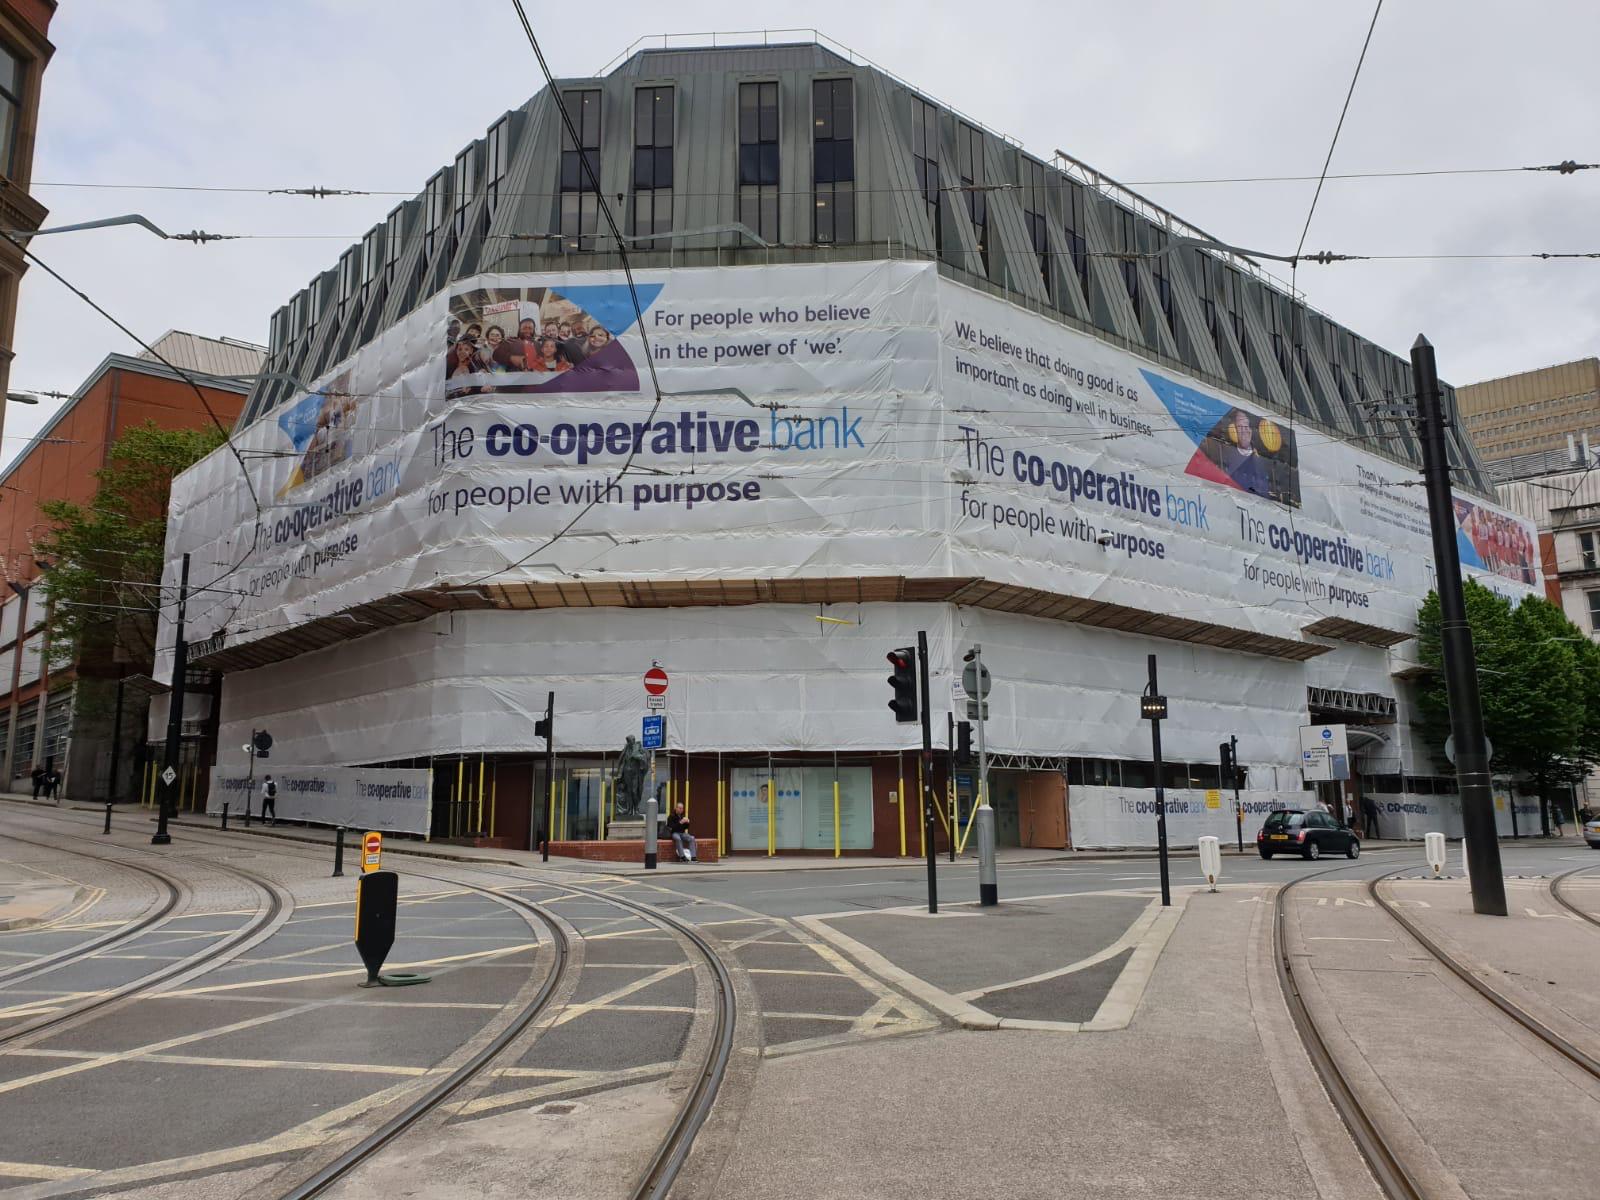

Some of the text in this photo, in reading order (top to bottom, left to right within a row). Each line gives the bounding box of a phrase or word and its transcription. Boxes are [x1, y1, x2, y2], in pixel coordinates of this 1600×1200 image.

[654, 304, 871, 330] For people who believe
[654, 344, 671, 360] in
[677, 342, 708, 359] the
[714, 342, 771, 362] power
[777, 339, 798, 356] of
[955, 320, 1138, 402] We believe that doing good is as
[955, 356, 1154, 437] important as doing well in business.
[430, 406, 865, 467] The co-operative bank
[275, 478, 364, 543] co-operative
[365, 456, 400, 500] bank
[428, 477, 761, 517] for people with purpose
[958, 425, 1210, 531] The co-operative bank
[960, 490, 988, 520] for
[993, 504, 1055, 537] people
[1060, 516, 1097, 543] with
[1236, 506, 1265, 545] The
[1268, 524, 1364, 573] co-operative
[1365, 545, 1395, 581] bank
[1243, 558, 1369, 608] for people with purpose
[367, 781, 411, 801] co-operative
[1136, 798, 1189, 814] co-orative
